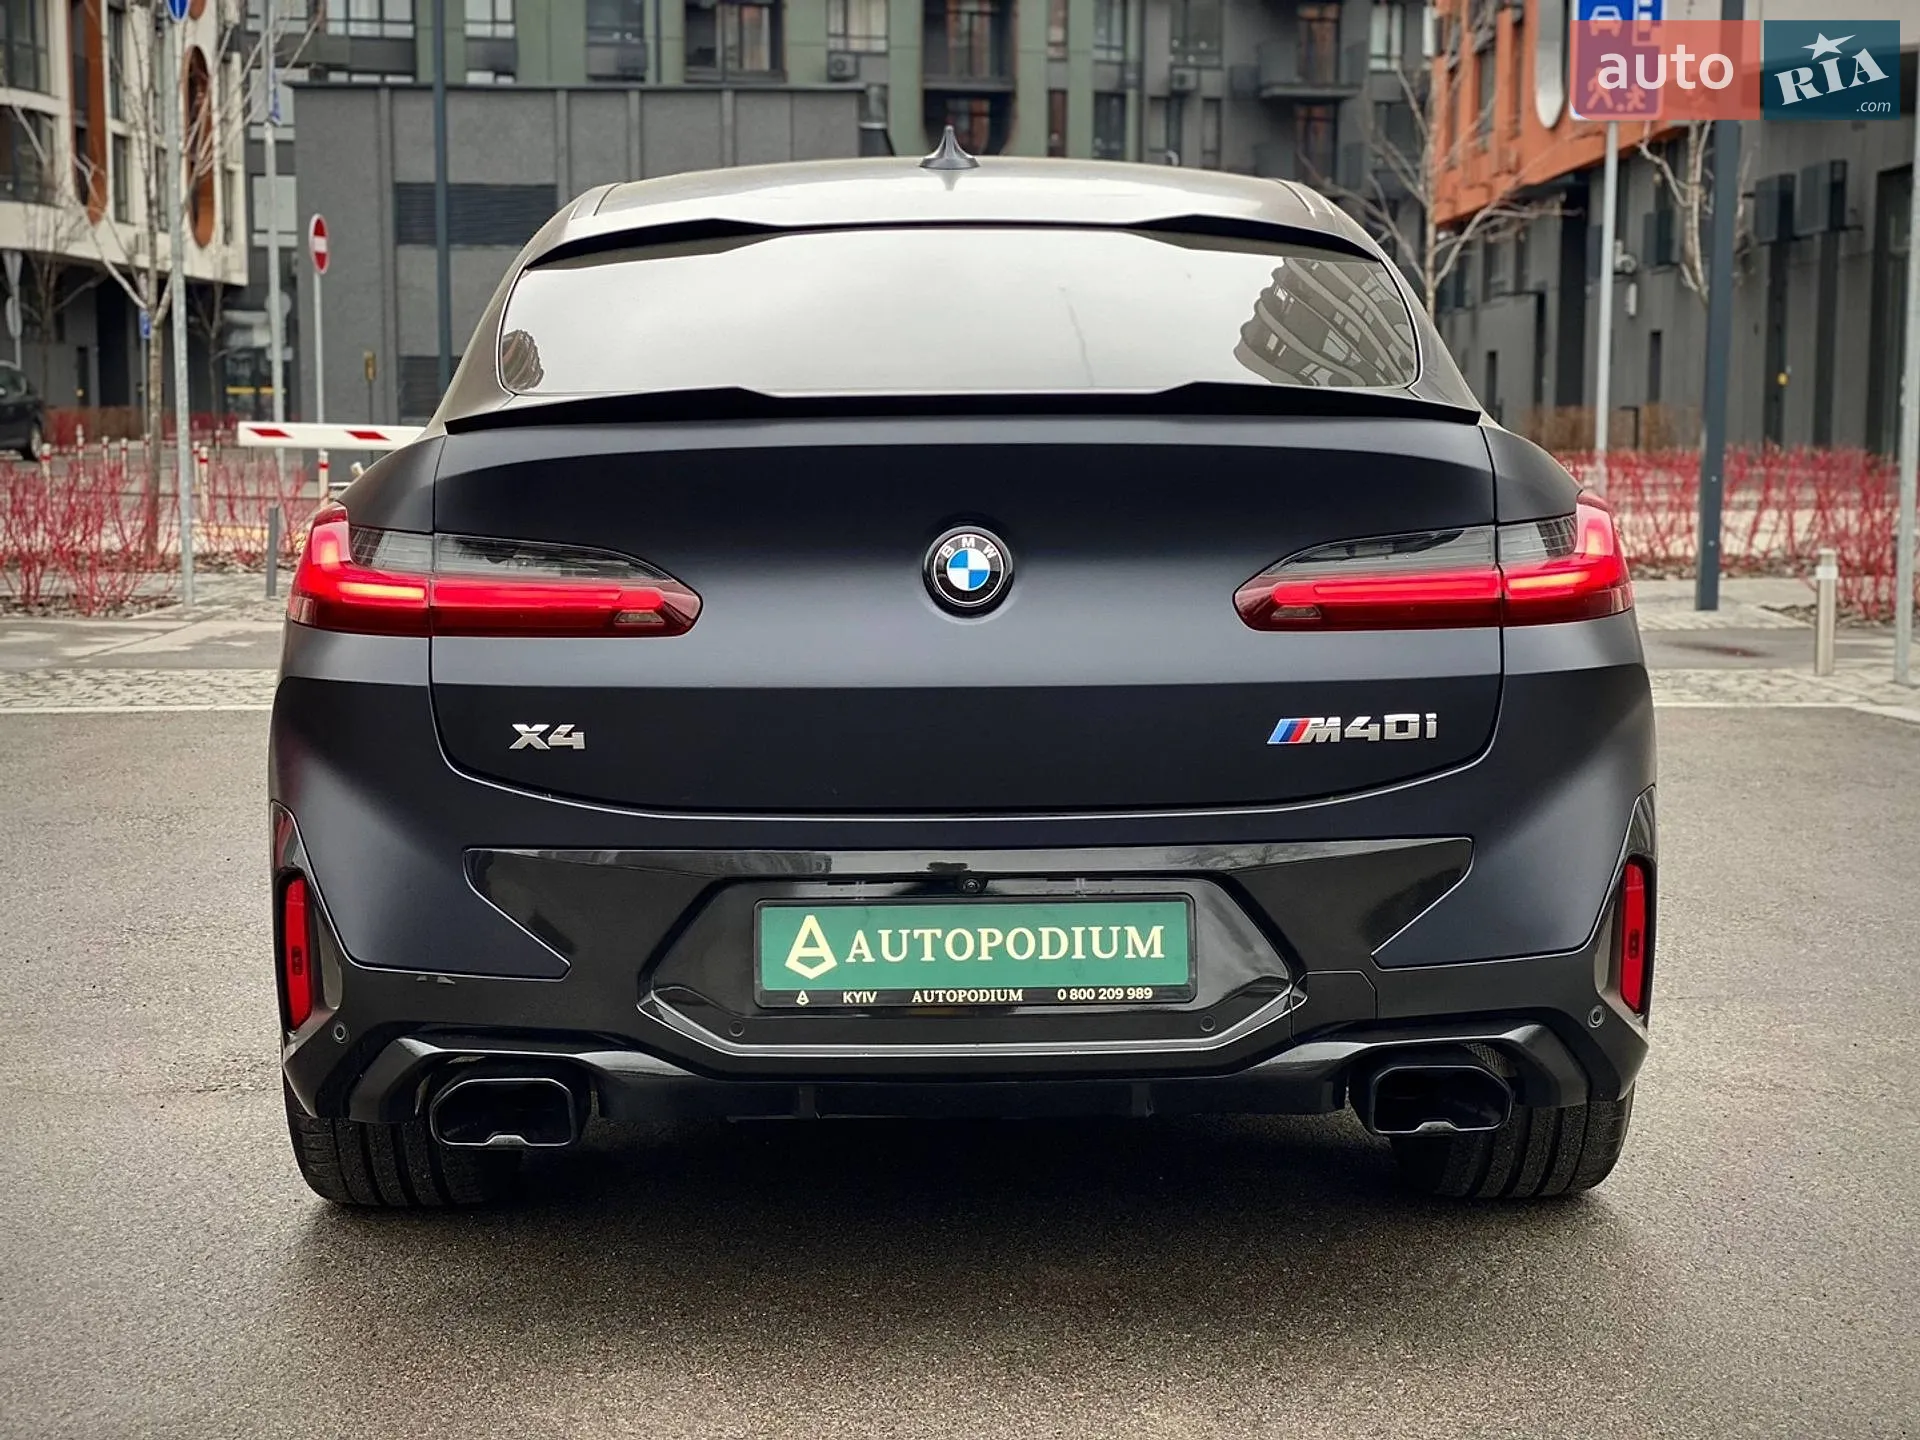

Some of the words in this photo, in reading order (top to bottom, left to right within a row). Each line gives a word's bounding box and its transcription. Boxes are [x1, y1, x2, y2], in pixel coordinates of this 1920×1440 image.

[941, 537, 997, 559] BMW
[509, 723, 585, 749] X4
[1299, 713, 1437, 743] M40i
[845, 926, 1165, 963] AUTOPODIUM
[842, 991, 877, 1003] KYIV
[912, 989, 1023, 1003] AUTOPODIUM
[1057, 988, 1067, 1000] 0
[1069, 988, 1095, 1000] 800
[1098, 987, 1124, 1000] 209
[1126, 987, 1153, 1000] 989
